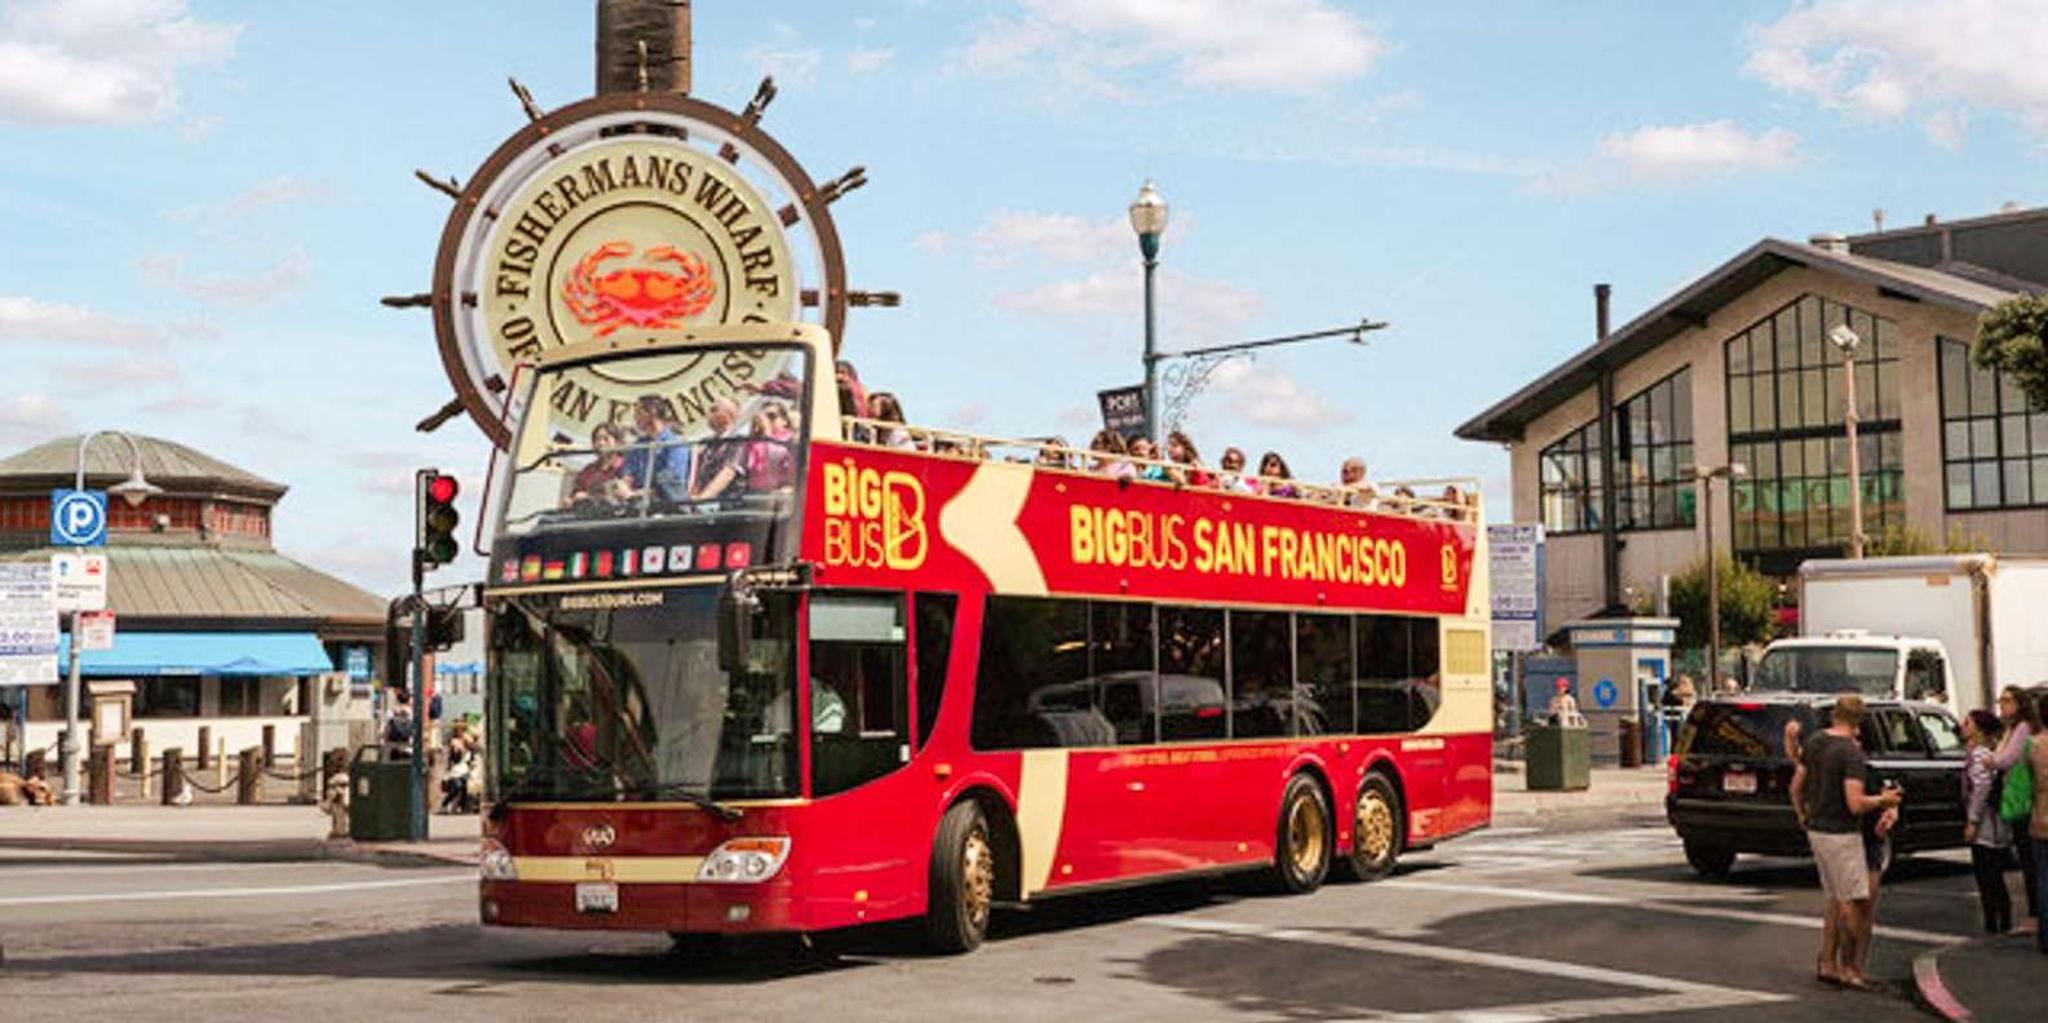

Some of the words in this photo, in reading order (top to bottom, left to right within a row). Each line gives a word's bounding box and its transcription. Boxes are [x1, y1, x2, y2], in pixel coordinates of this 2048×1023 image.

[496, 155, 693, 299] FISHERMANS
[694, 167, 780, 300] WHARF
[549, 369, 600, 423] AN
[69, 501, 92, 532] P
[823, 457, 882, 519] BIG
[824, 517, 885, 569] BUS
[1194, 517, 1256, 576] SAN
[1262, 526, 1407, 588] FRANCISCO
